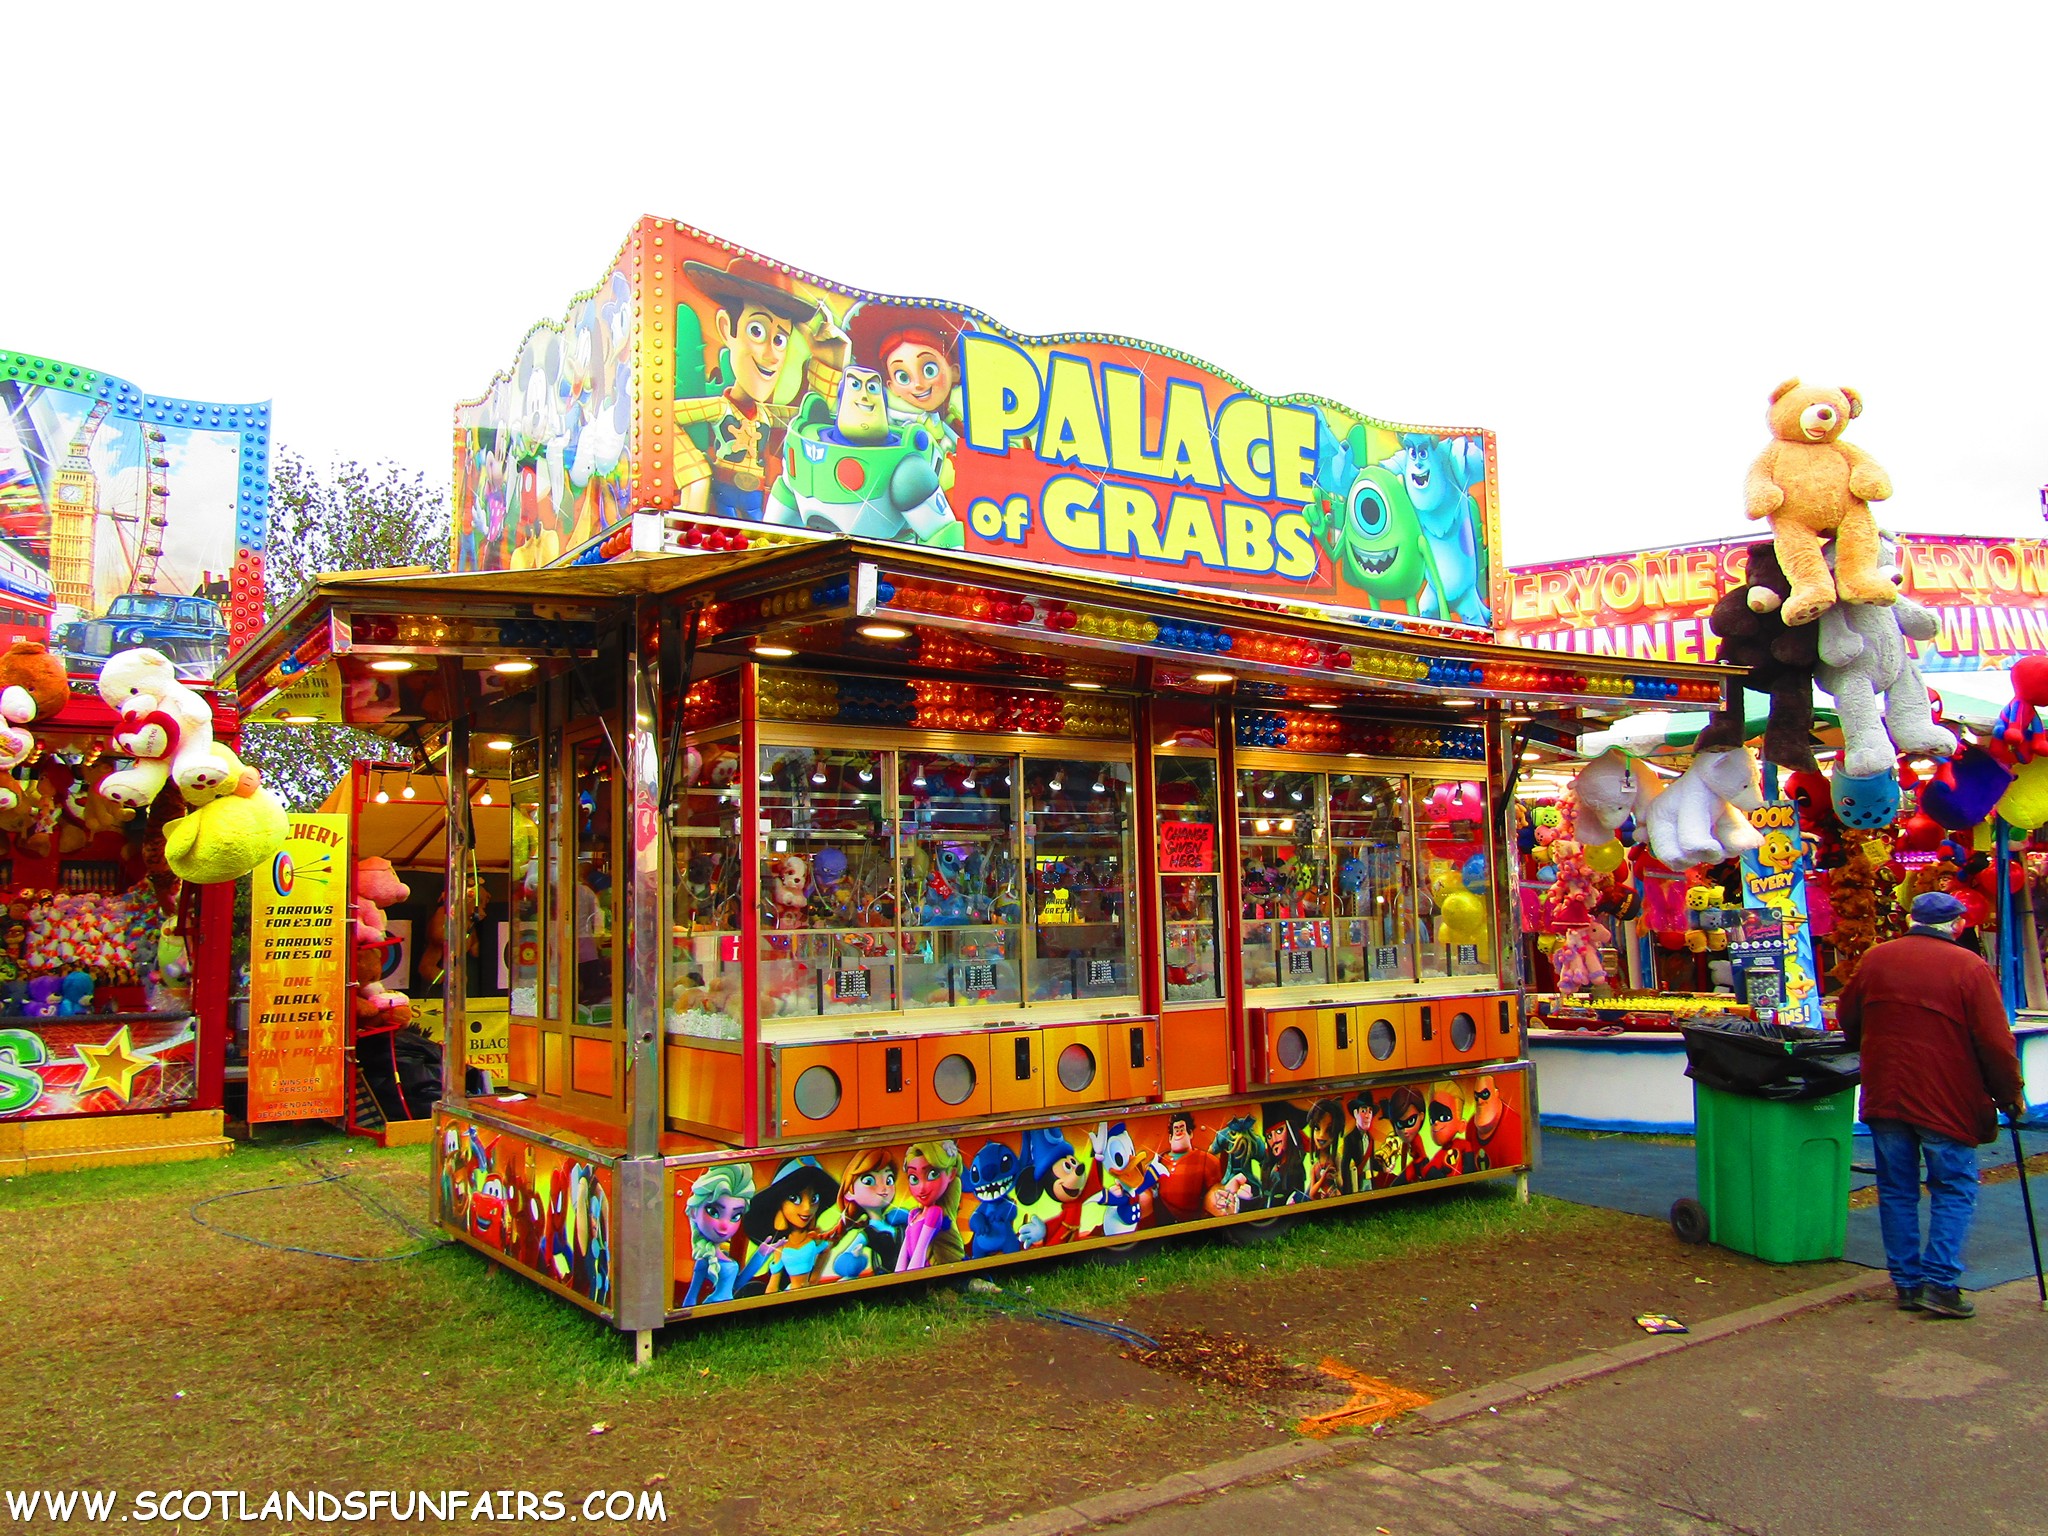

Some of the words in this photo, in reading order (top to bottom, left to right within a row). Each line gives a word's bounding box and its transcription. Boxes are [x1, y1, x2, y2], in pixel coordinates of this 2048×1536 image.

[960, 332, 1320, 504] PALACE
[968, 494, 1031, 544] of
[1040, 473, 1319, 580] GRABS
[1896, 544, 2048, 597] ERYON
[1926, 606, 2048, 657] WINN
[285, 823, 344, 848] HERY
[1165, 826, 1209, 841] CHANGE
[1166, 841, 1202, 855] GIVEN
[1169, 854, 1203, 867] HERE
[1750, 871, 1795, 894] EVERY
[265, 906, 274, 915] 3
[277, 905, 334, 915] ARROWS
[265, 918, 291, 928] FOR
[293, 918, 333, 928] £3.00
[264, 938, 274, 947] 6
[276, 937, 333, 947] ARROWS
[265, 951, 291, 960] FOR
[292, 950, 332, 960] £5.00
[283, 976, 314, 987] ONE
[273, 994, 322, 1005] BLACK
[259, 1010, 335, 1024] BULLSEYE
[1779, 1005, 1811, 1025] INS!
[271, 1030, 290, 1041] TO
[294, 1029, 324, 1040] WIN
[470, 1038, 508, 1050] BLAC
[259, 1048, 290, 1060] ANY
[292, 1046, 335, 1058] PRIZE
[280, 1078, 301, 1086] WINS
[303, 1077, 321, 1085] PER
[257, 1110, 297, 1119] DECISION
[310, 1107, 334, 1115] FINAL
